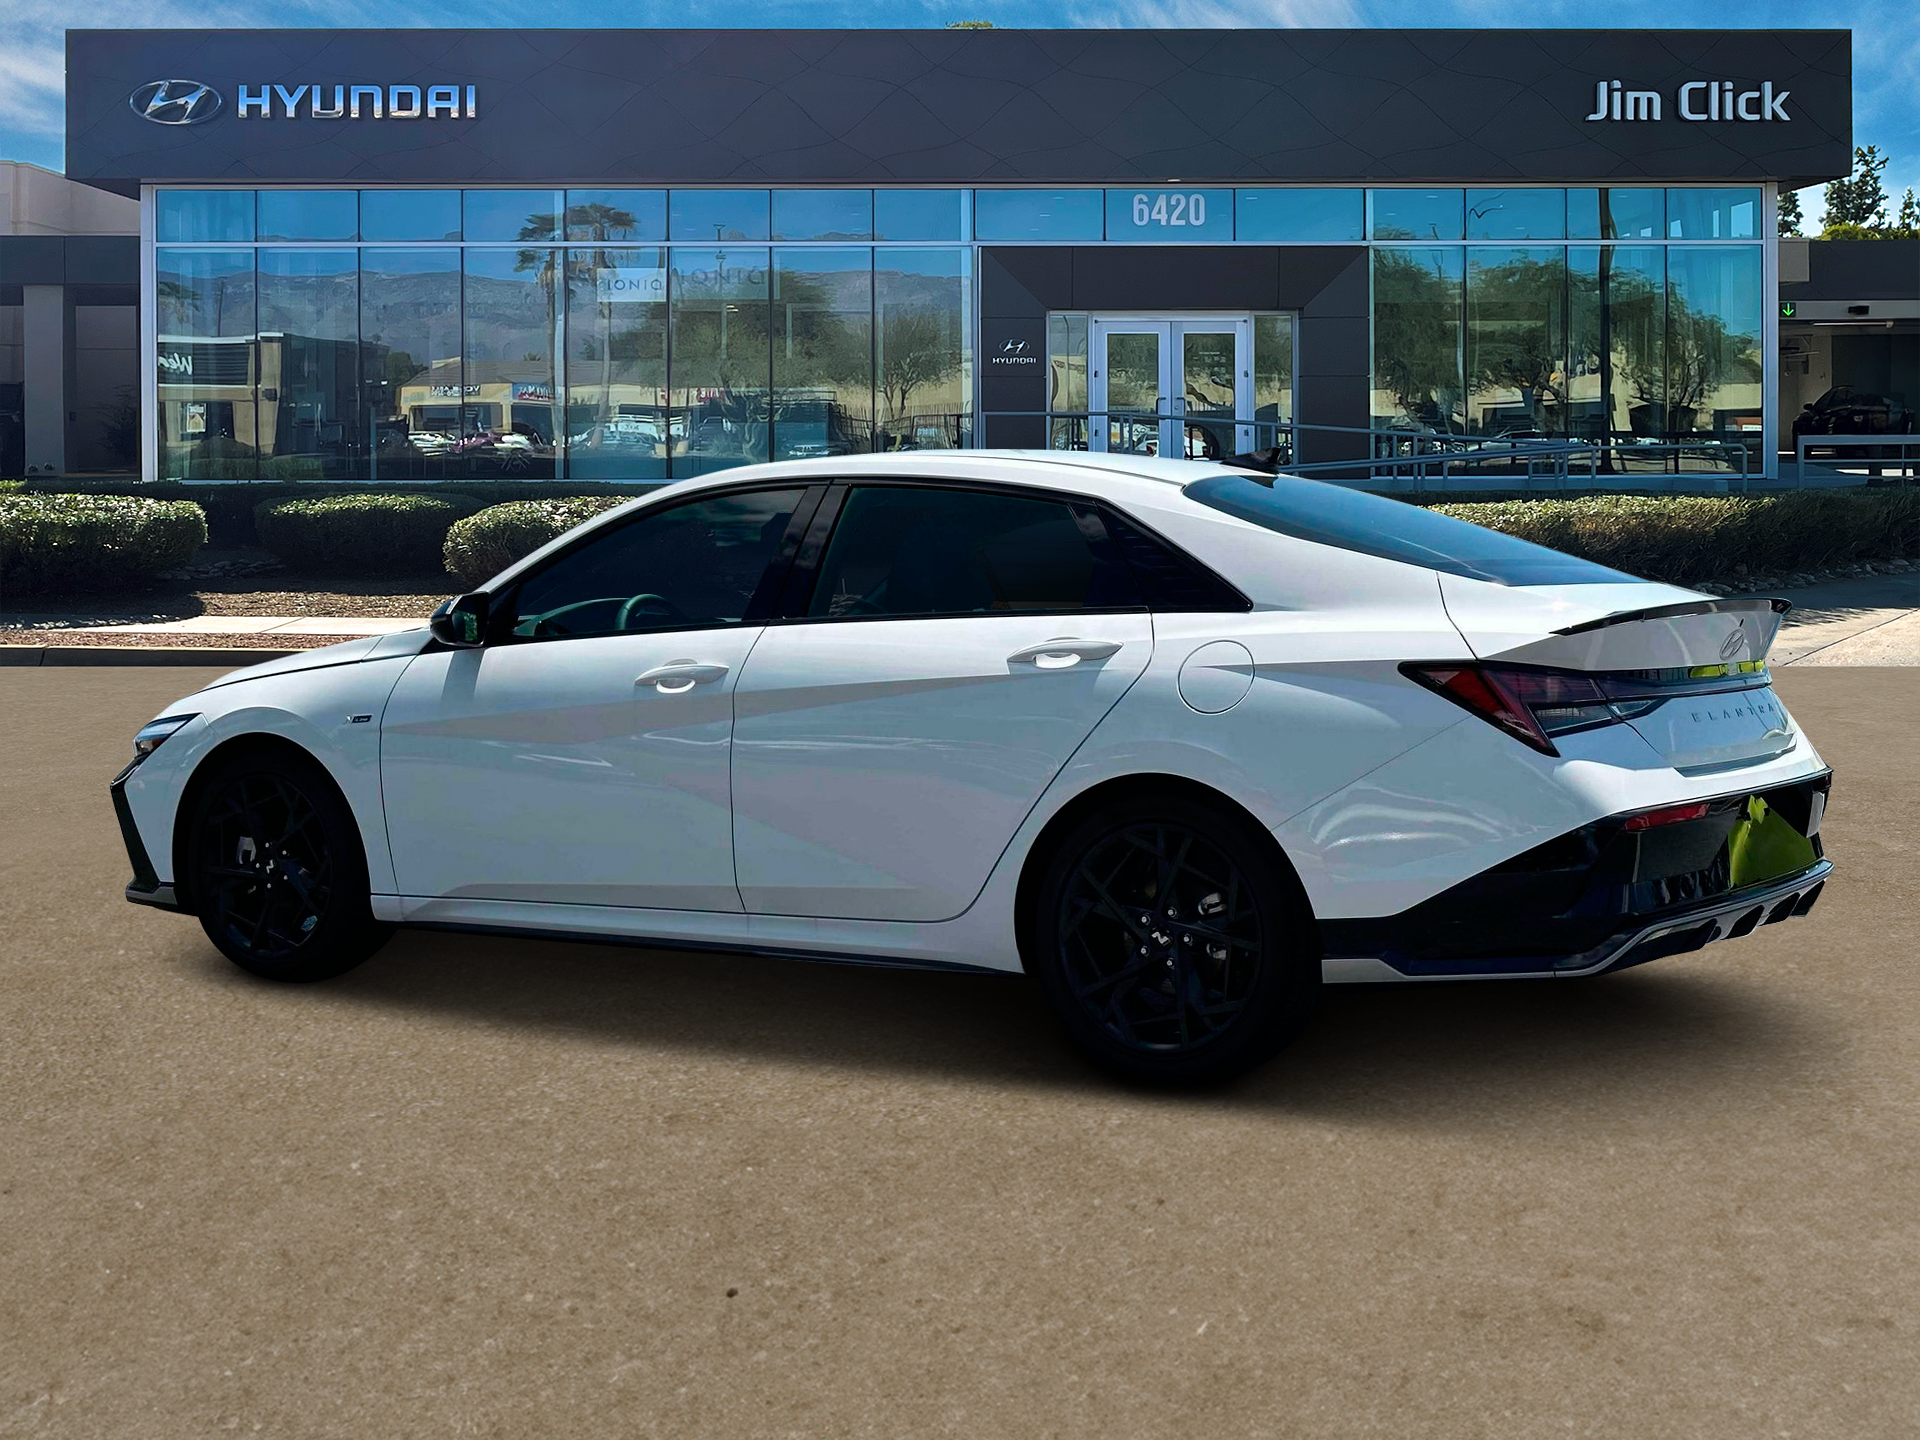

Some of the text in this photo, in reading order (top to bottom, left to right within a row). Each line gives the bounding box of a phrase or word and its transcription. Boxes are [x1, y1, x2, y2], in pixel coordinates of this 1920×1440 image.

[238, 84, 476, 119] HYUNDAI
[1585, 79, 1791, 121] Jim Click
[1133, 193, 1205, 226] 6420
[607, 278, 662, 291] IONIQ
[992, 357, 1037, 365] HYUNDAI
[1690, 703, 1775, 723] ELANTRA
